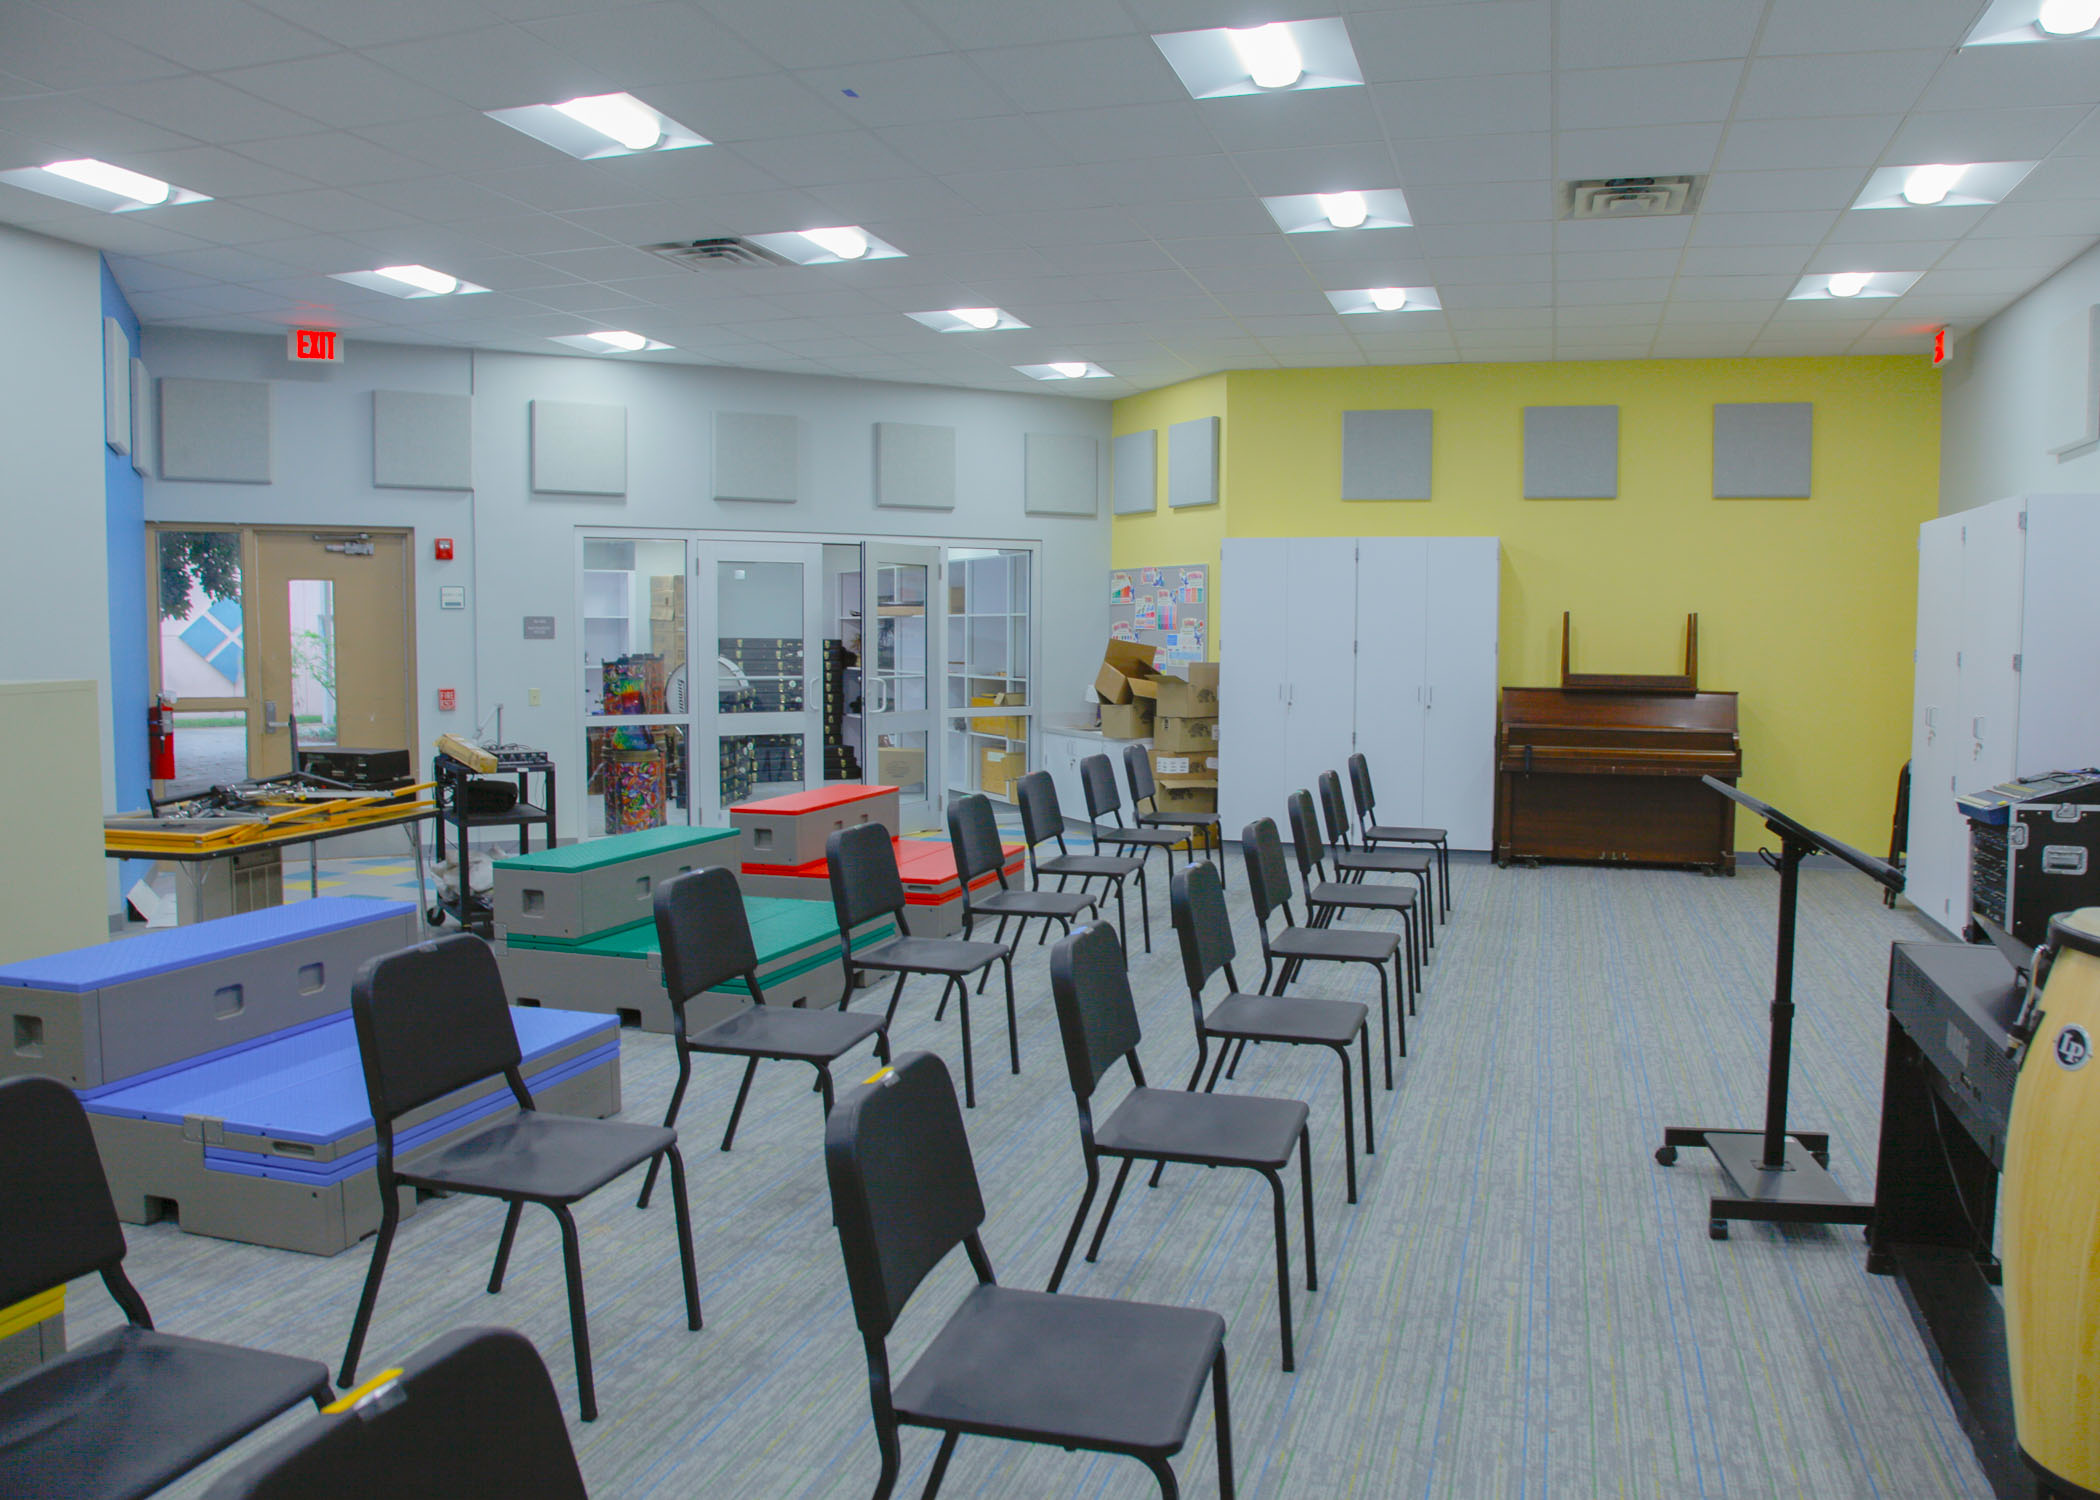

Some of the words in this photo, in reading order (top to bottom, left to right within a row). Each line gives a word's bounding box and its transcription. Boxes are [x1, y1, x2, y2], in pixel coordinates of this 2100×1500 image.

[297, 330, 336, 360] EXIT
[440, 691, 454, 700] FIRE
[2058, 1032, 2085, 1063] LP
